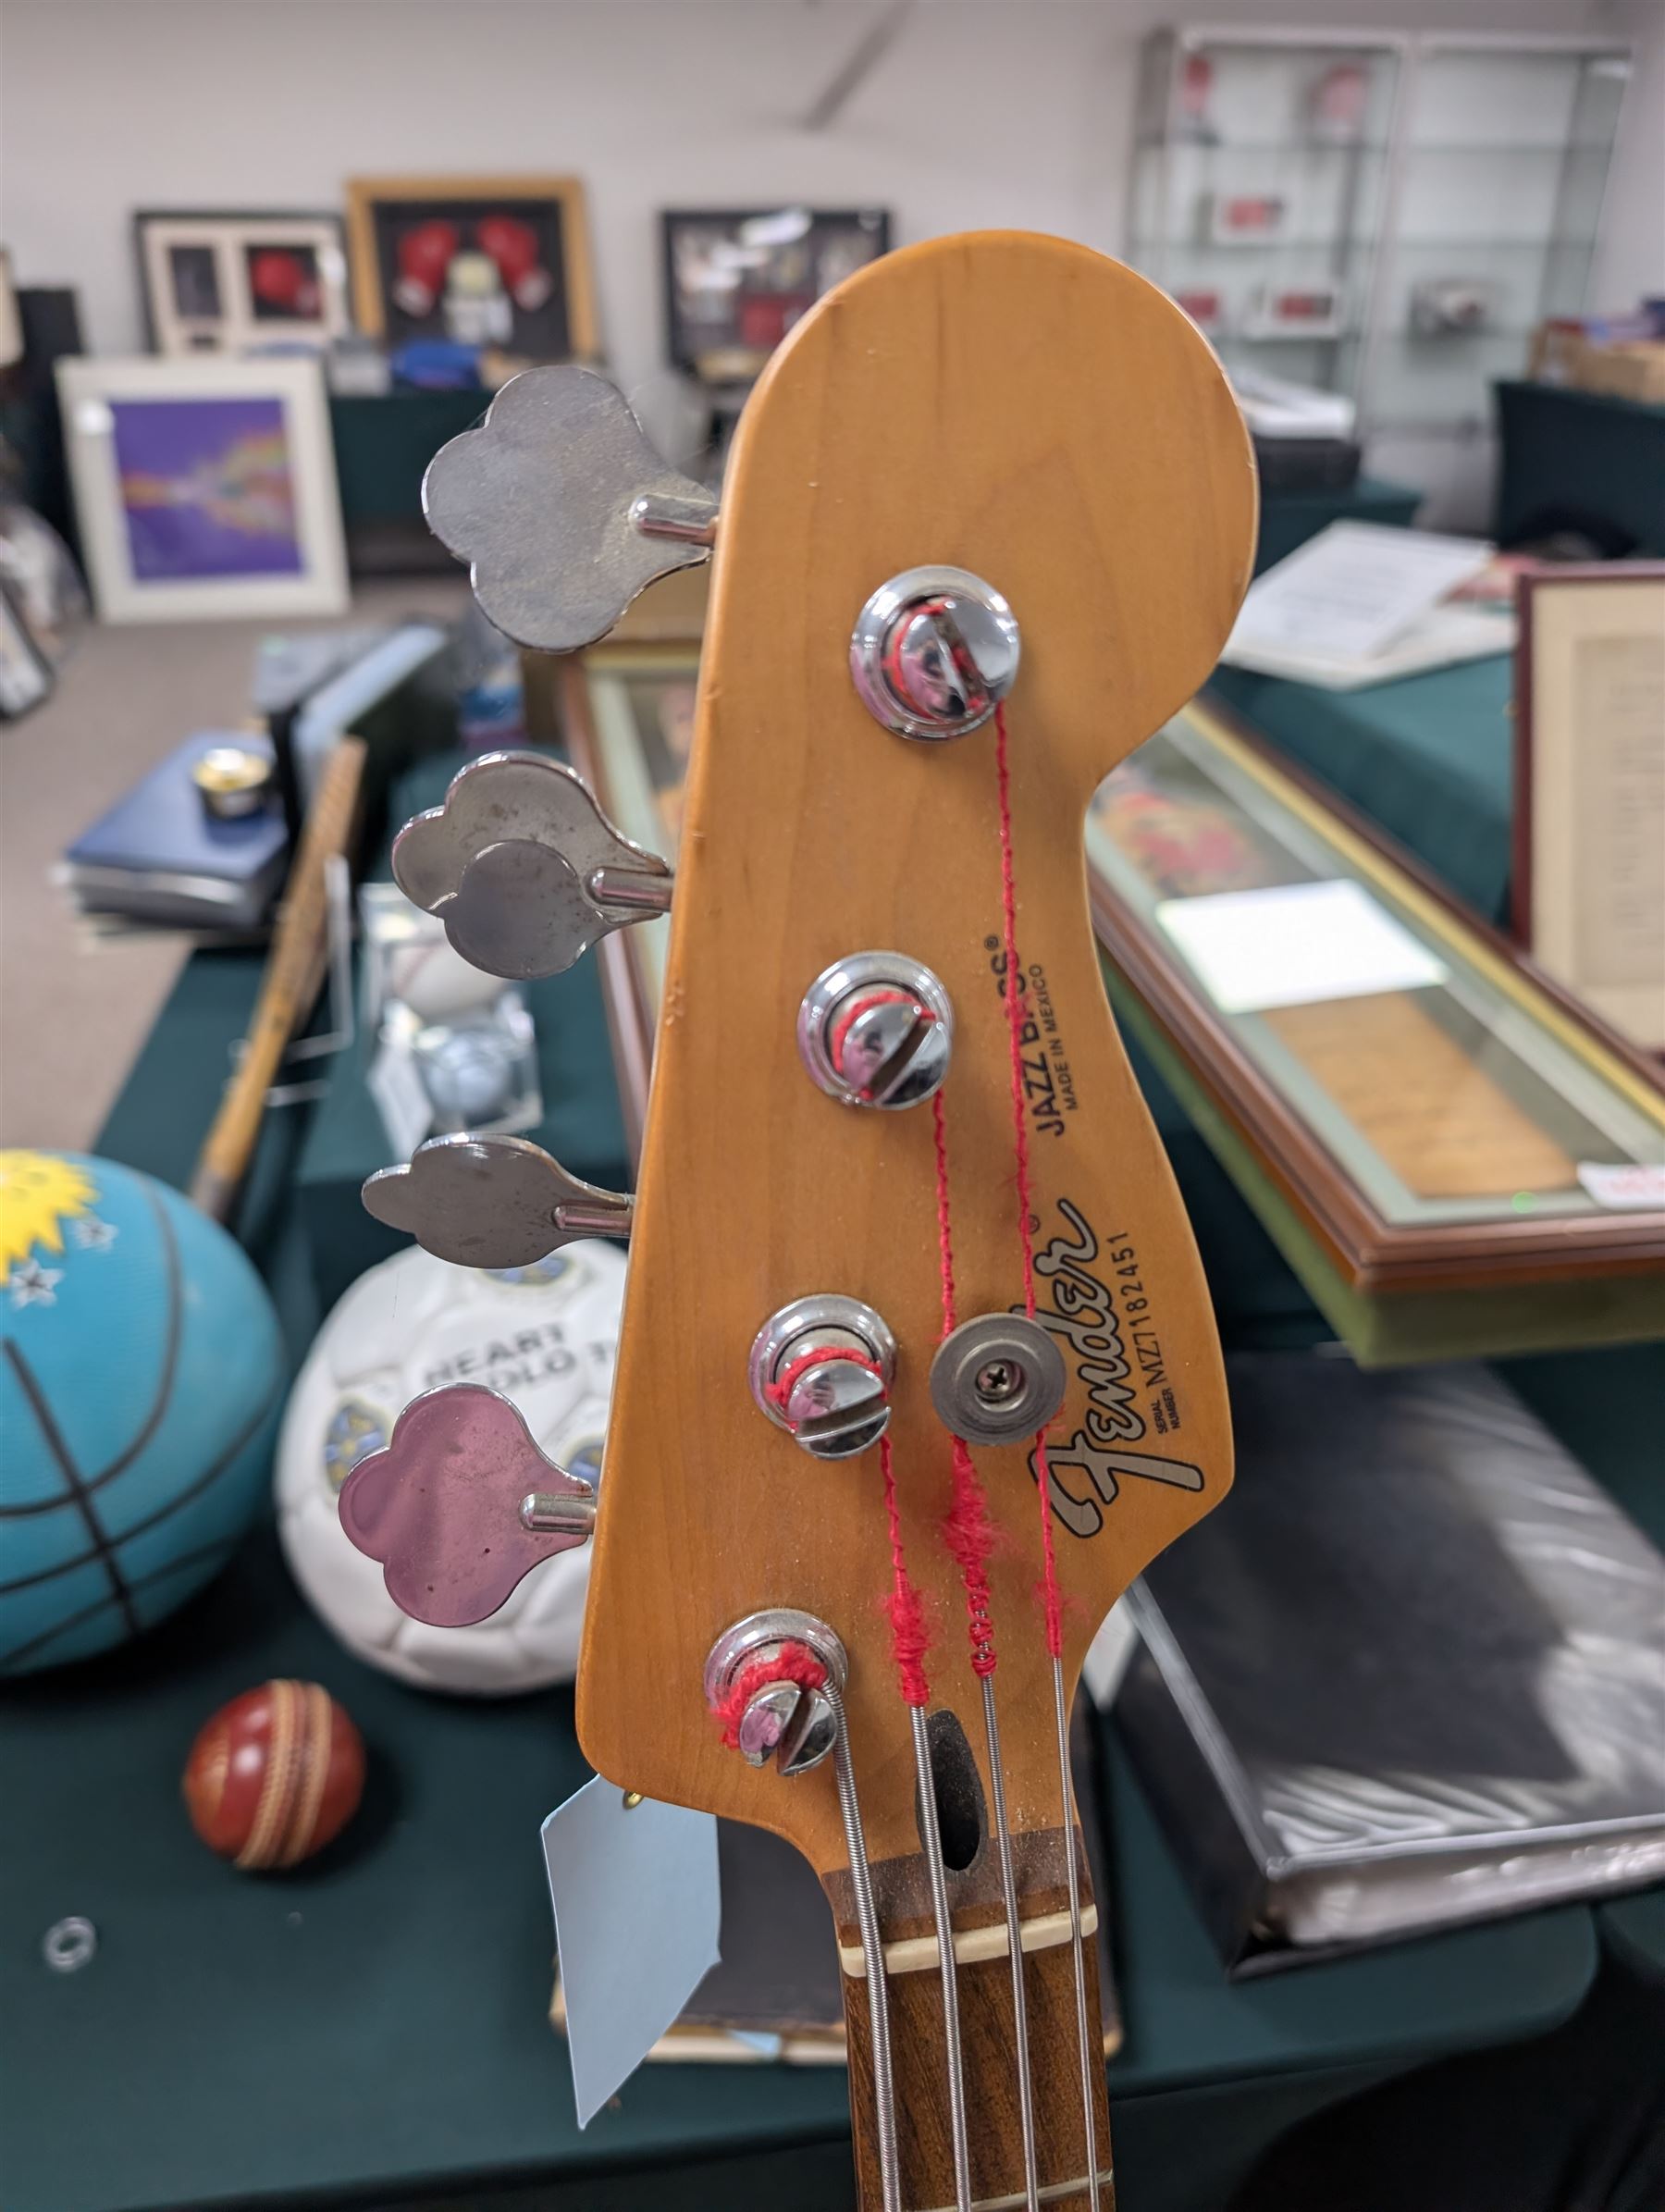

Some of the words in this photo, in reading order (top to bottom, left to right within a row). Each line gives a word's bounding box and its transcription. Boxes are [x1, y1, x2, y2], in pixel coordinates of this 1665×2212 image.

[1028, 963, 1058, 1033] MEXICO
[1049, 1037, 1065, 1058] IN
[1020, 1051, 1066, 1138] JAZZ
[1054, 1062, 1079, 1111] MADE
[1106, 1231, 1168, 1388] MZ7182451
[424, 1320, 566, 1384] HEART
[1008, 1197, 1205, 1539] Fender
[1151, 1399, 1168, 1435] SERIAL
[1161, 1387, 1181, 1430] NUMBER
